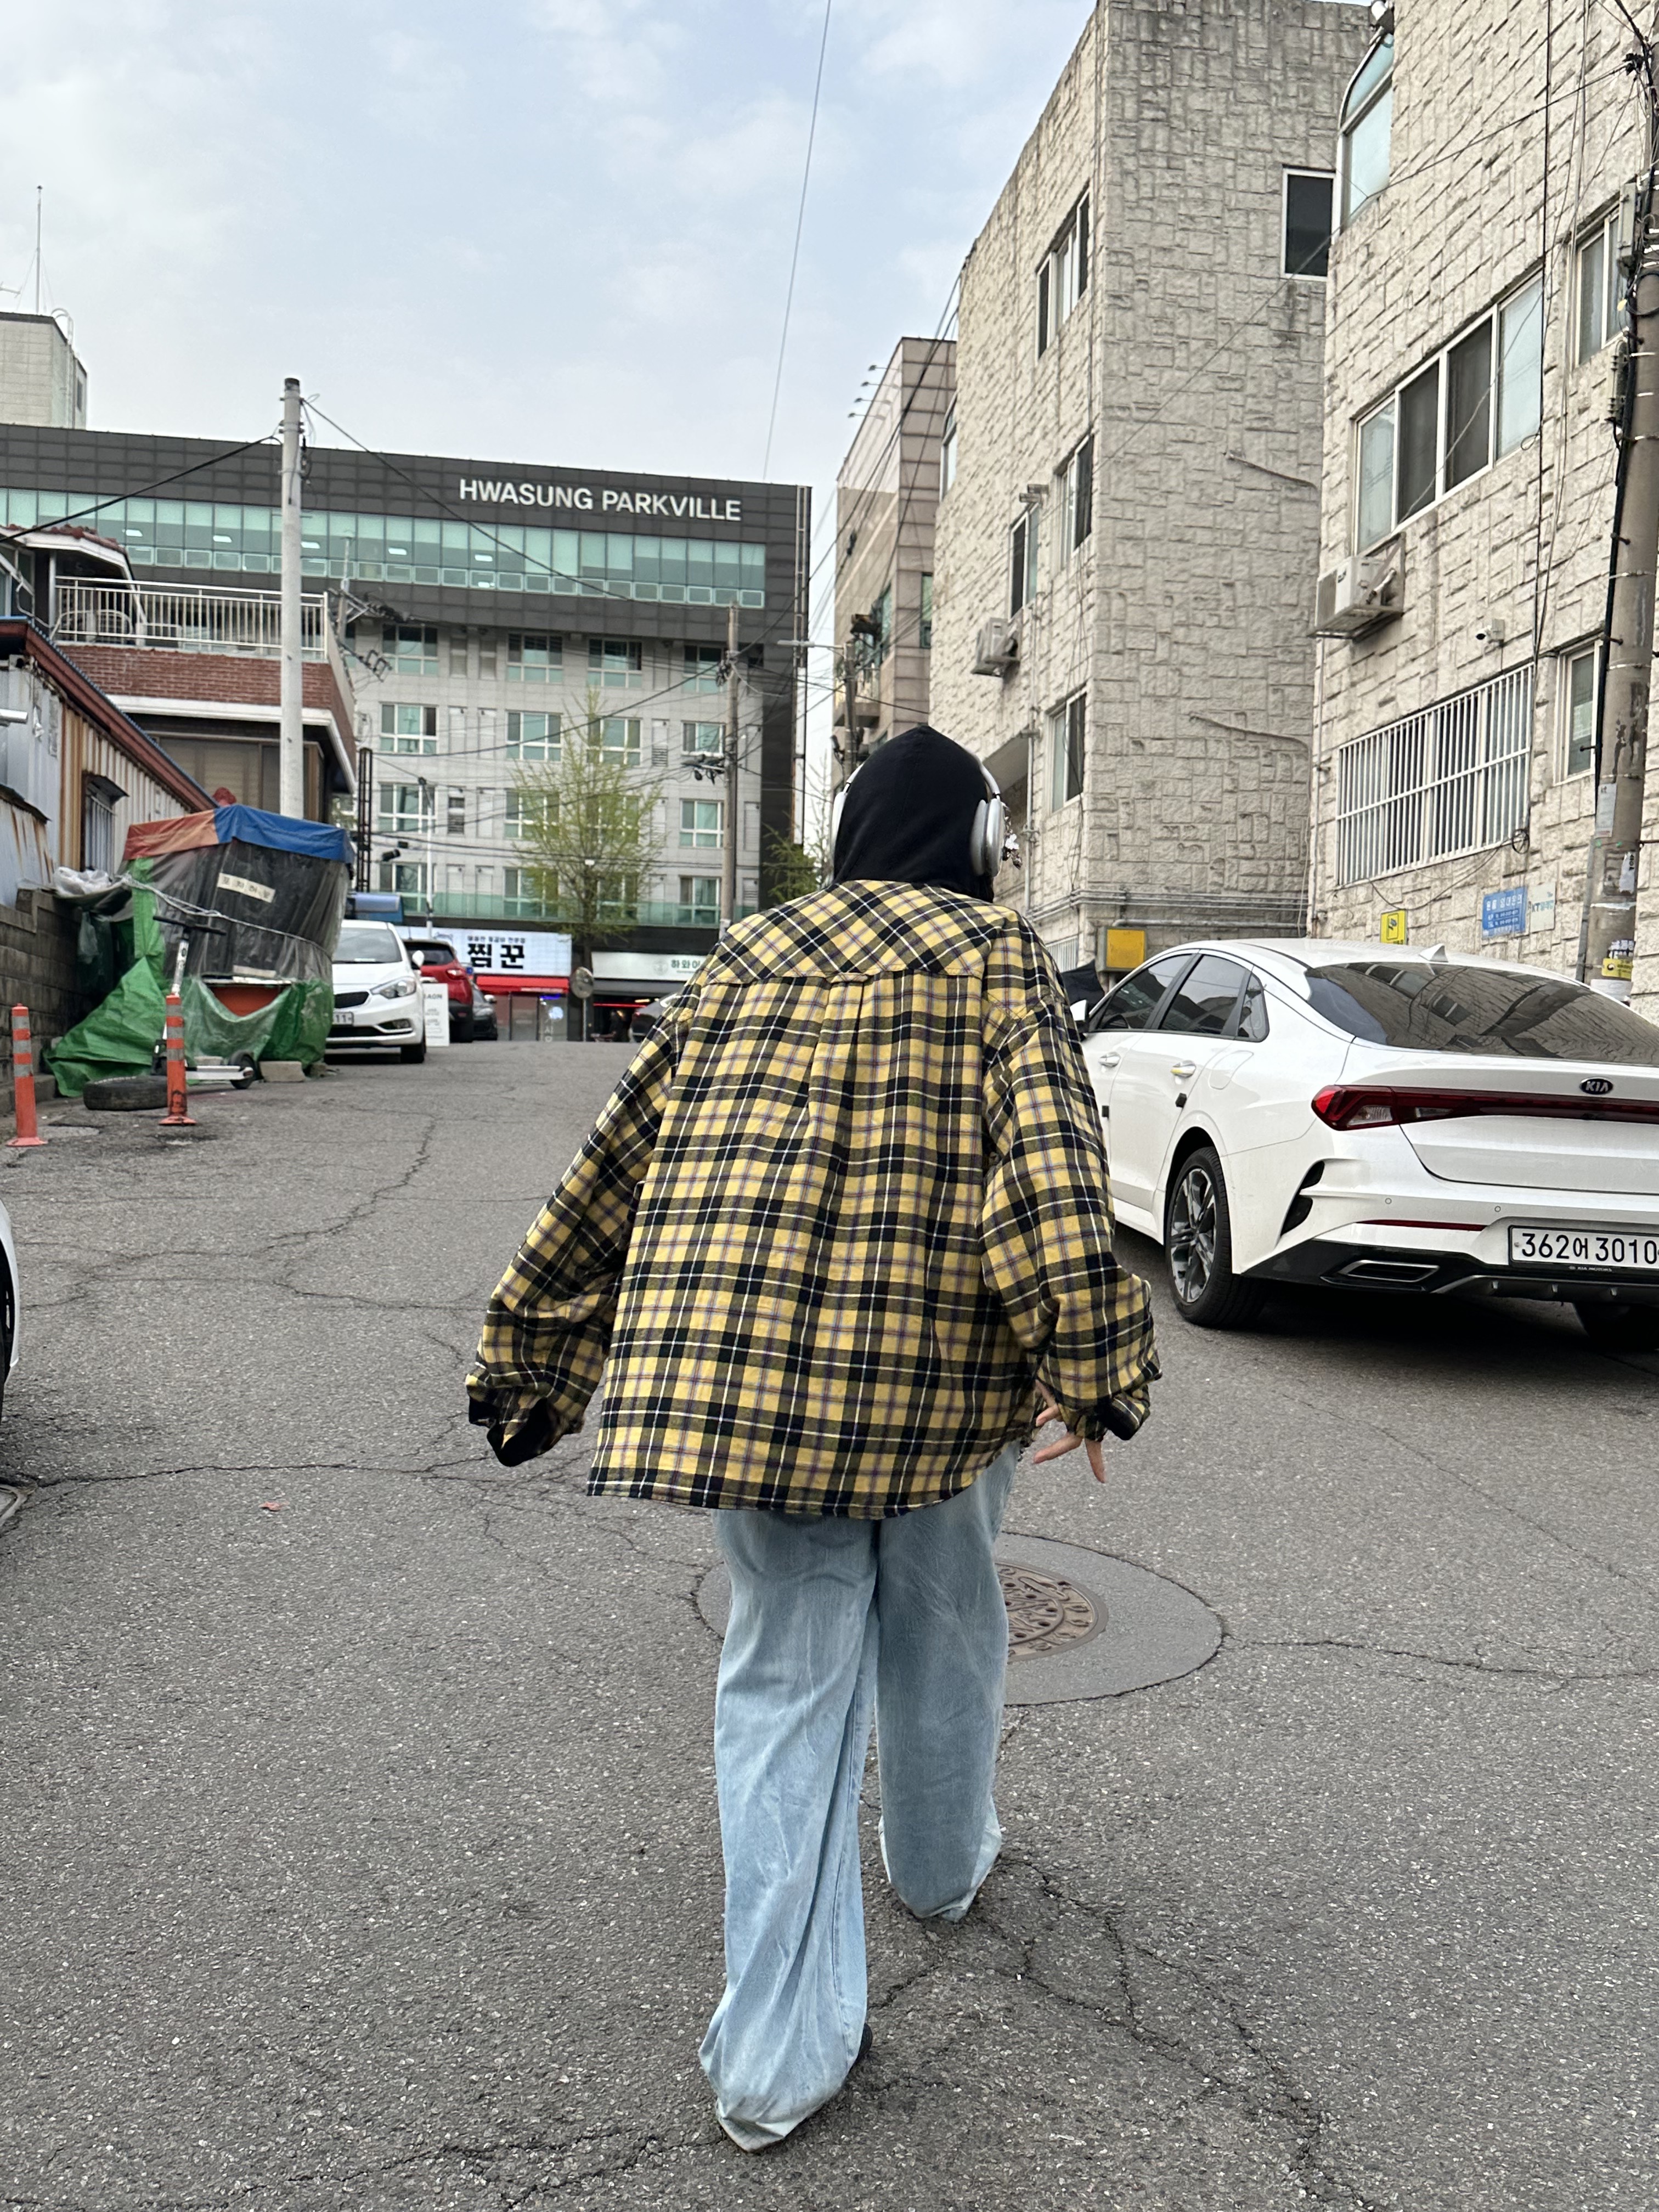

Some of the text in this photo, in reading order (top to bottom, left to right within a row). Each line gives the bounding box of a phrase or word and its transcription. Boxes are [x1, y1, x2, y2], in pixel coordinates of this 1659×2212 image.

[459, 478, 742, 521] HWASUNG PARKVILLE
[1585, 1081, 1609, 1092] KIA
[1522, 1233, 1657, 1265] 362어 3010
